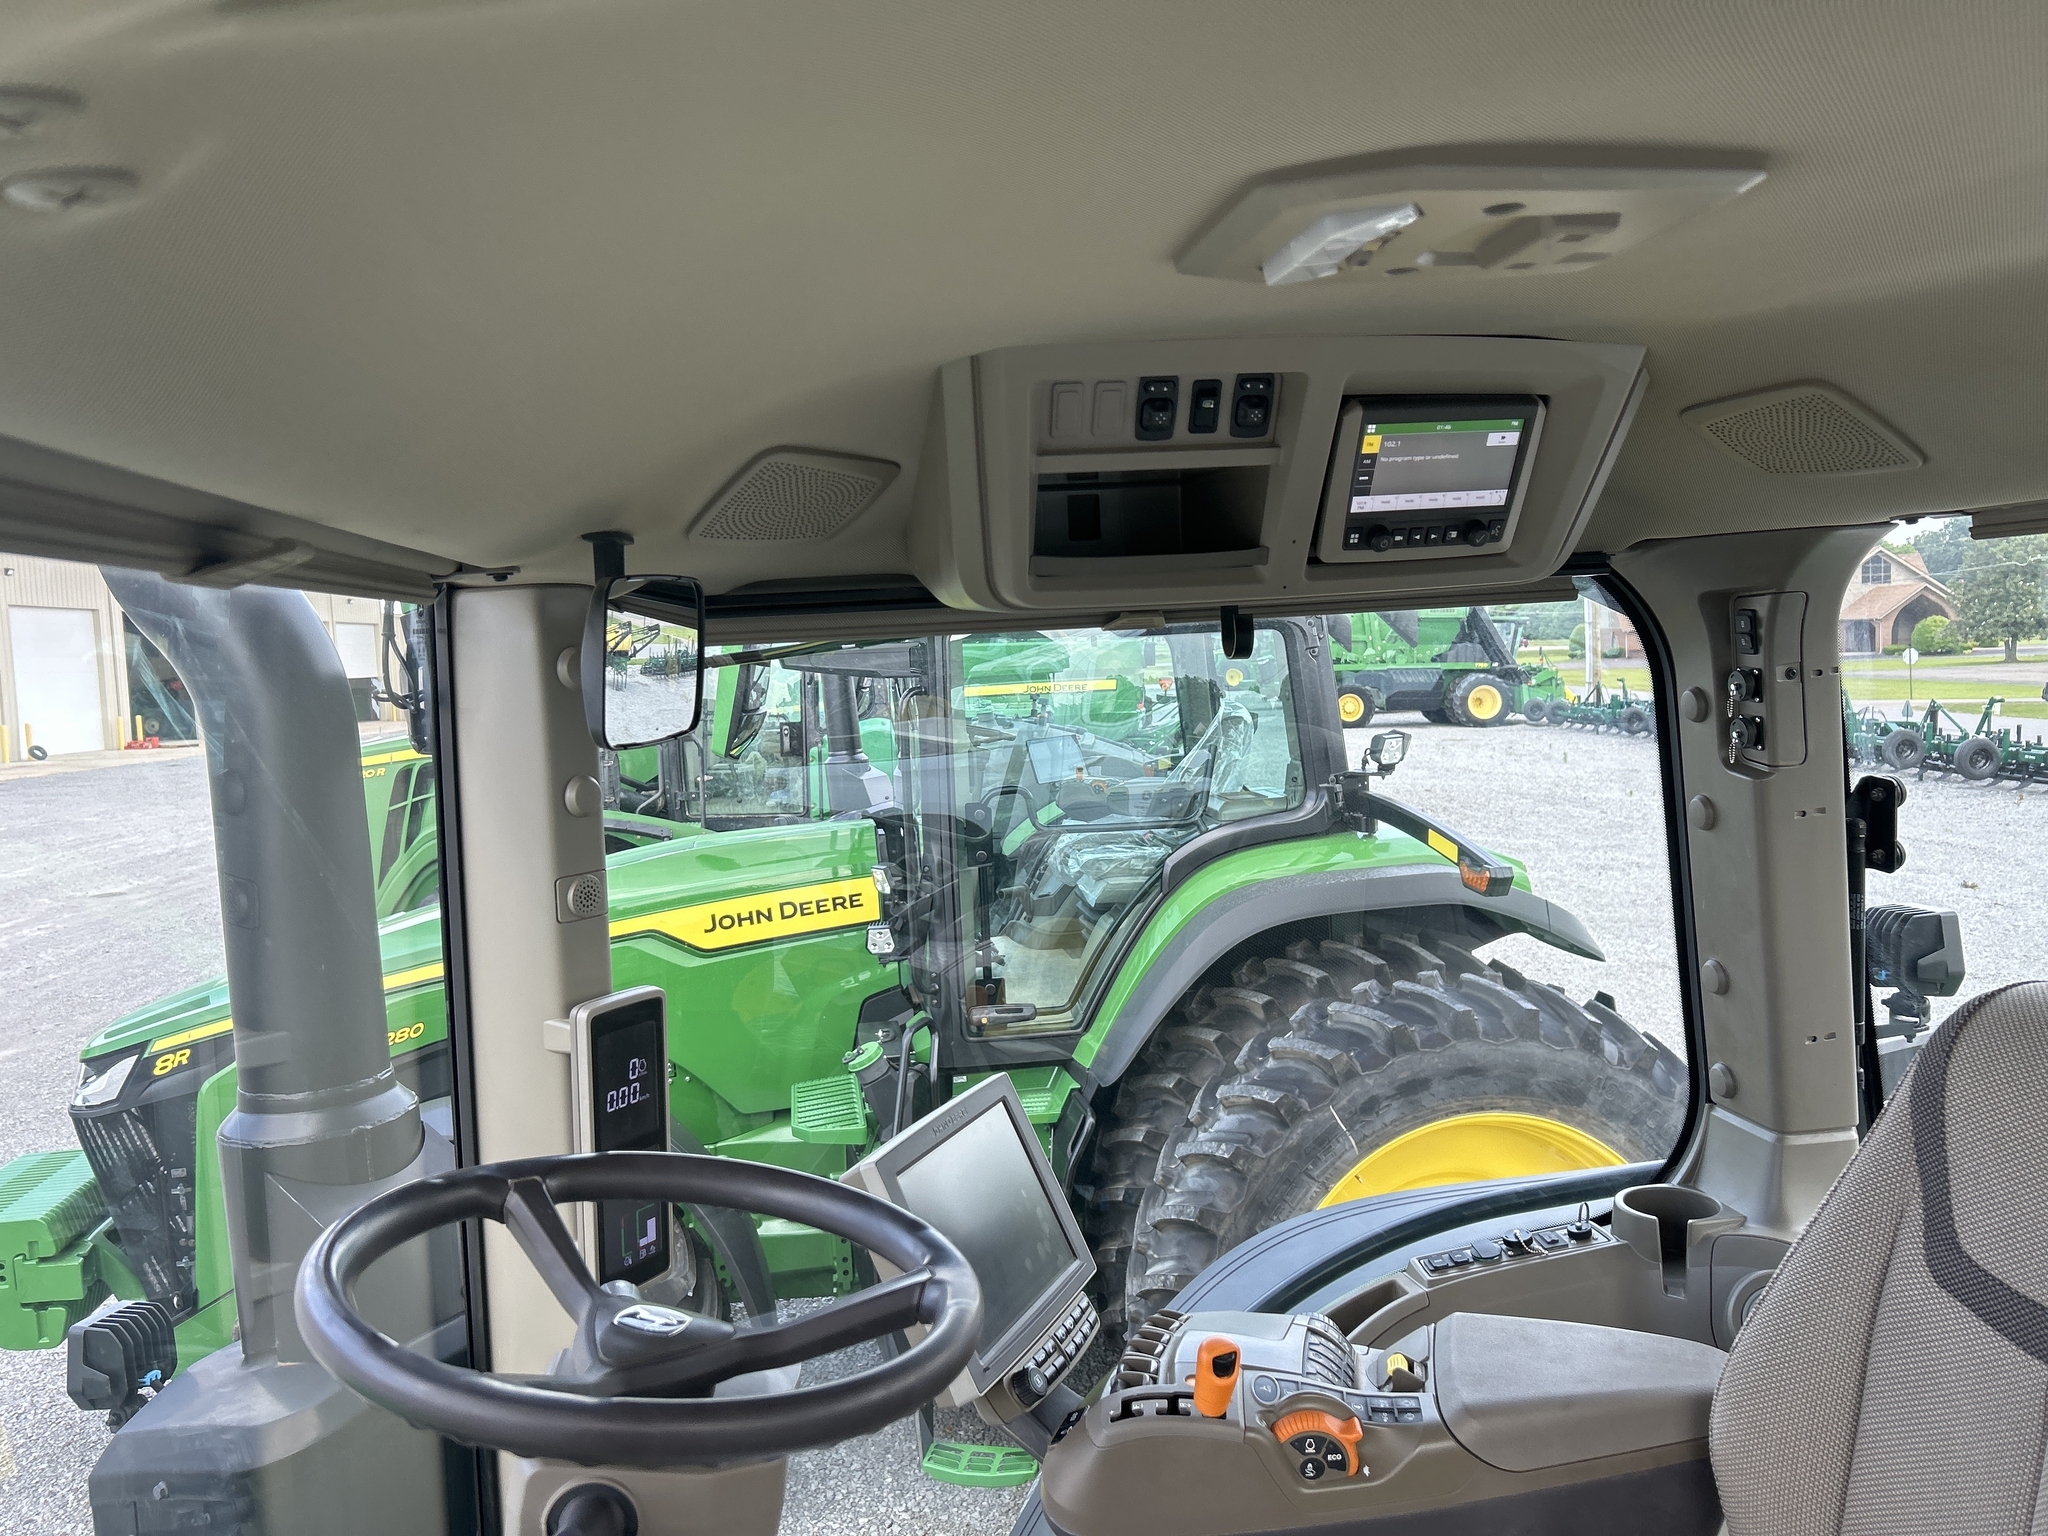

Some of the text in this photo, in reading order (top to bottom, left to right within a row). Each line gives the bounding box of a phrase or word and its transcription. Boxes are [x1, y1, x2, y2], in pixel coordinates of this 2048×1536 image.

[1384, 440, 1401, 448] 102.1
[1389, 455, 1412, 463] program
[1023, 683, 1088, 694] JOHN DEERE
[704, 892, 864, 934] JOHN DEERE
[153, 1048, 191, 1076] 8R
[607, 1082, 640, 1113] 0.00
[1327, 1453, 1342, 1461] ECO
